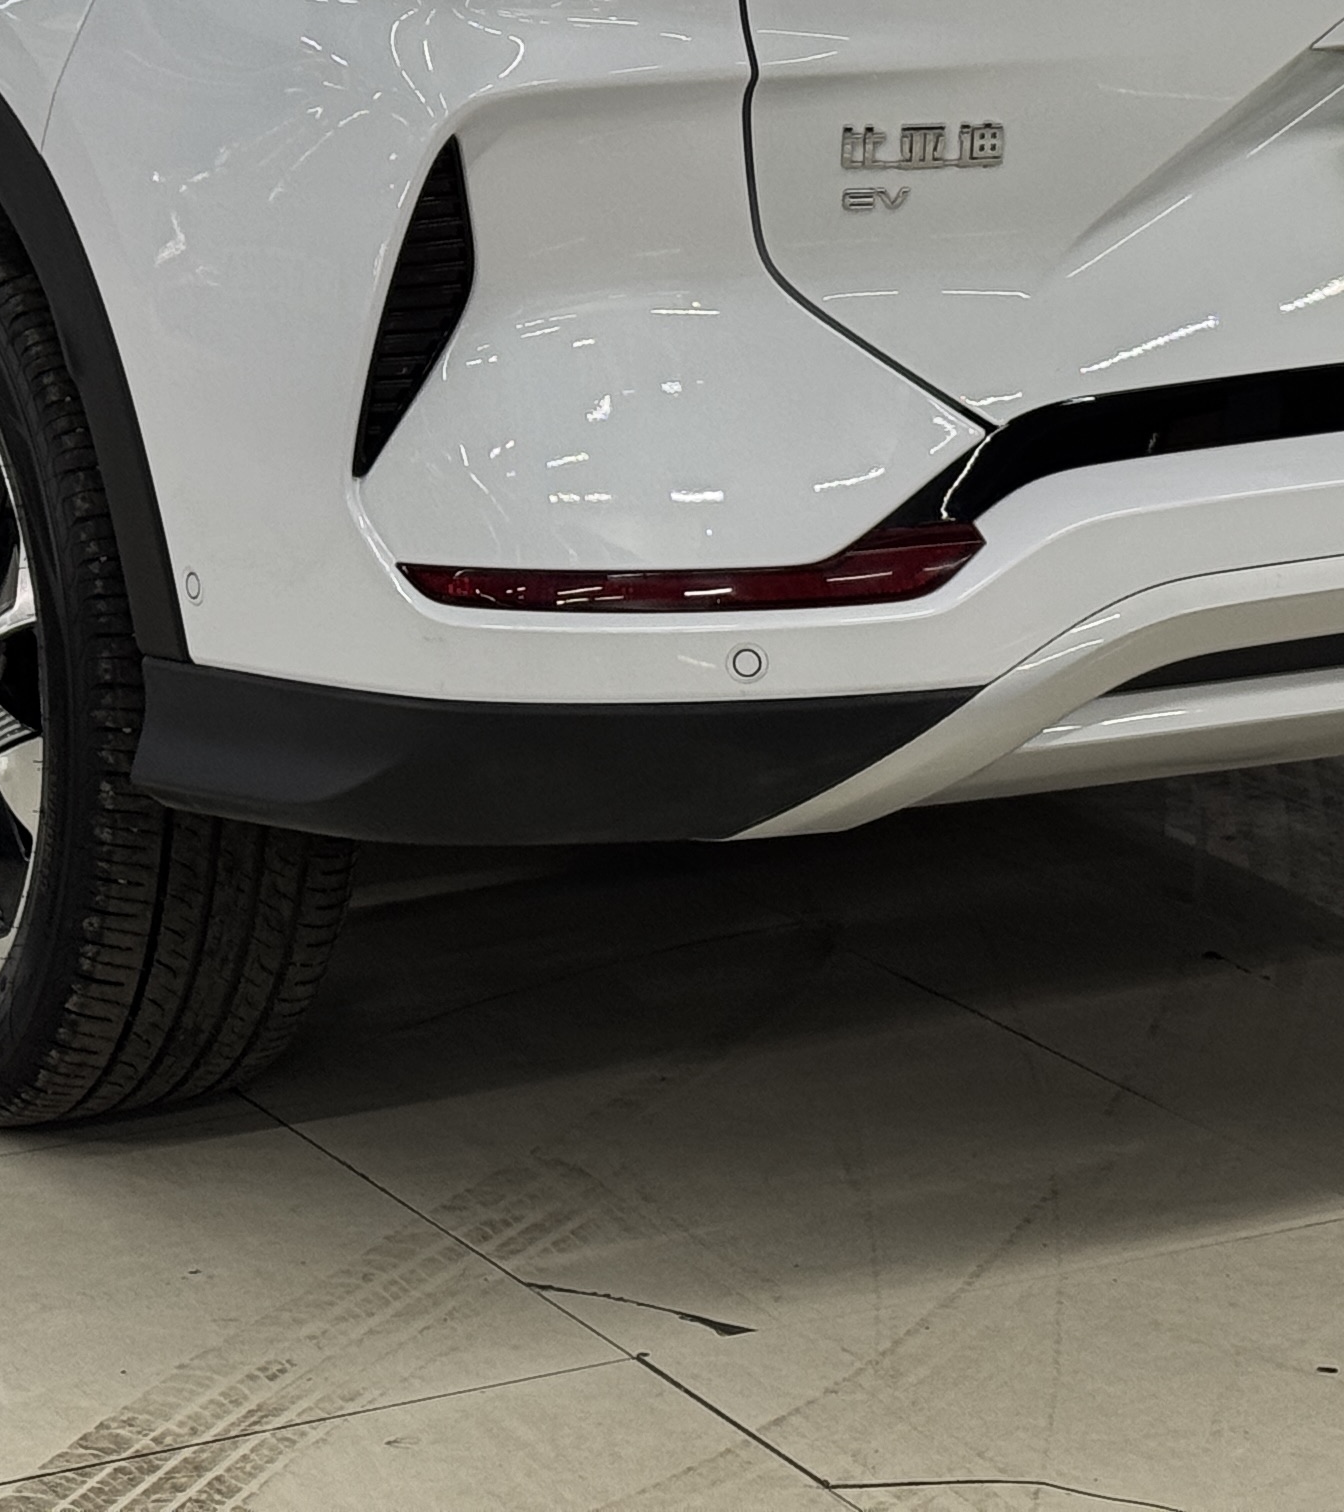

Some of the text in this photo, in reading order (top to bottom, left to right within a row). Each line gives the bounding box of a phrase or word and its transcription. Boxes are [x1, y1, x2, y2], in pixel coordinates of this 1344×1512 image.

[840, 120, 1004, 170] 比亚迪
[842, 187, 910, 212] EV
